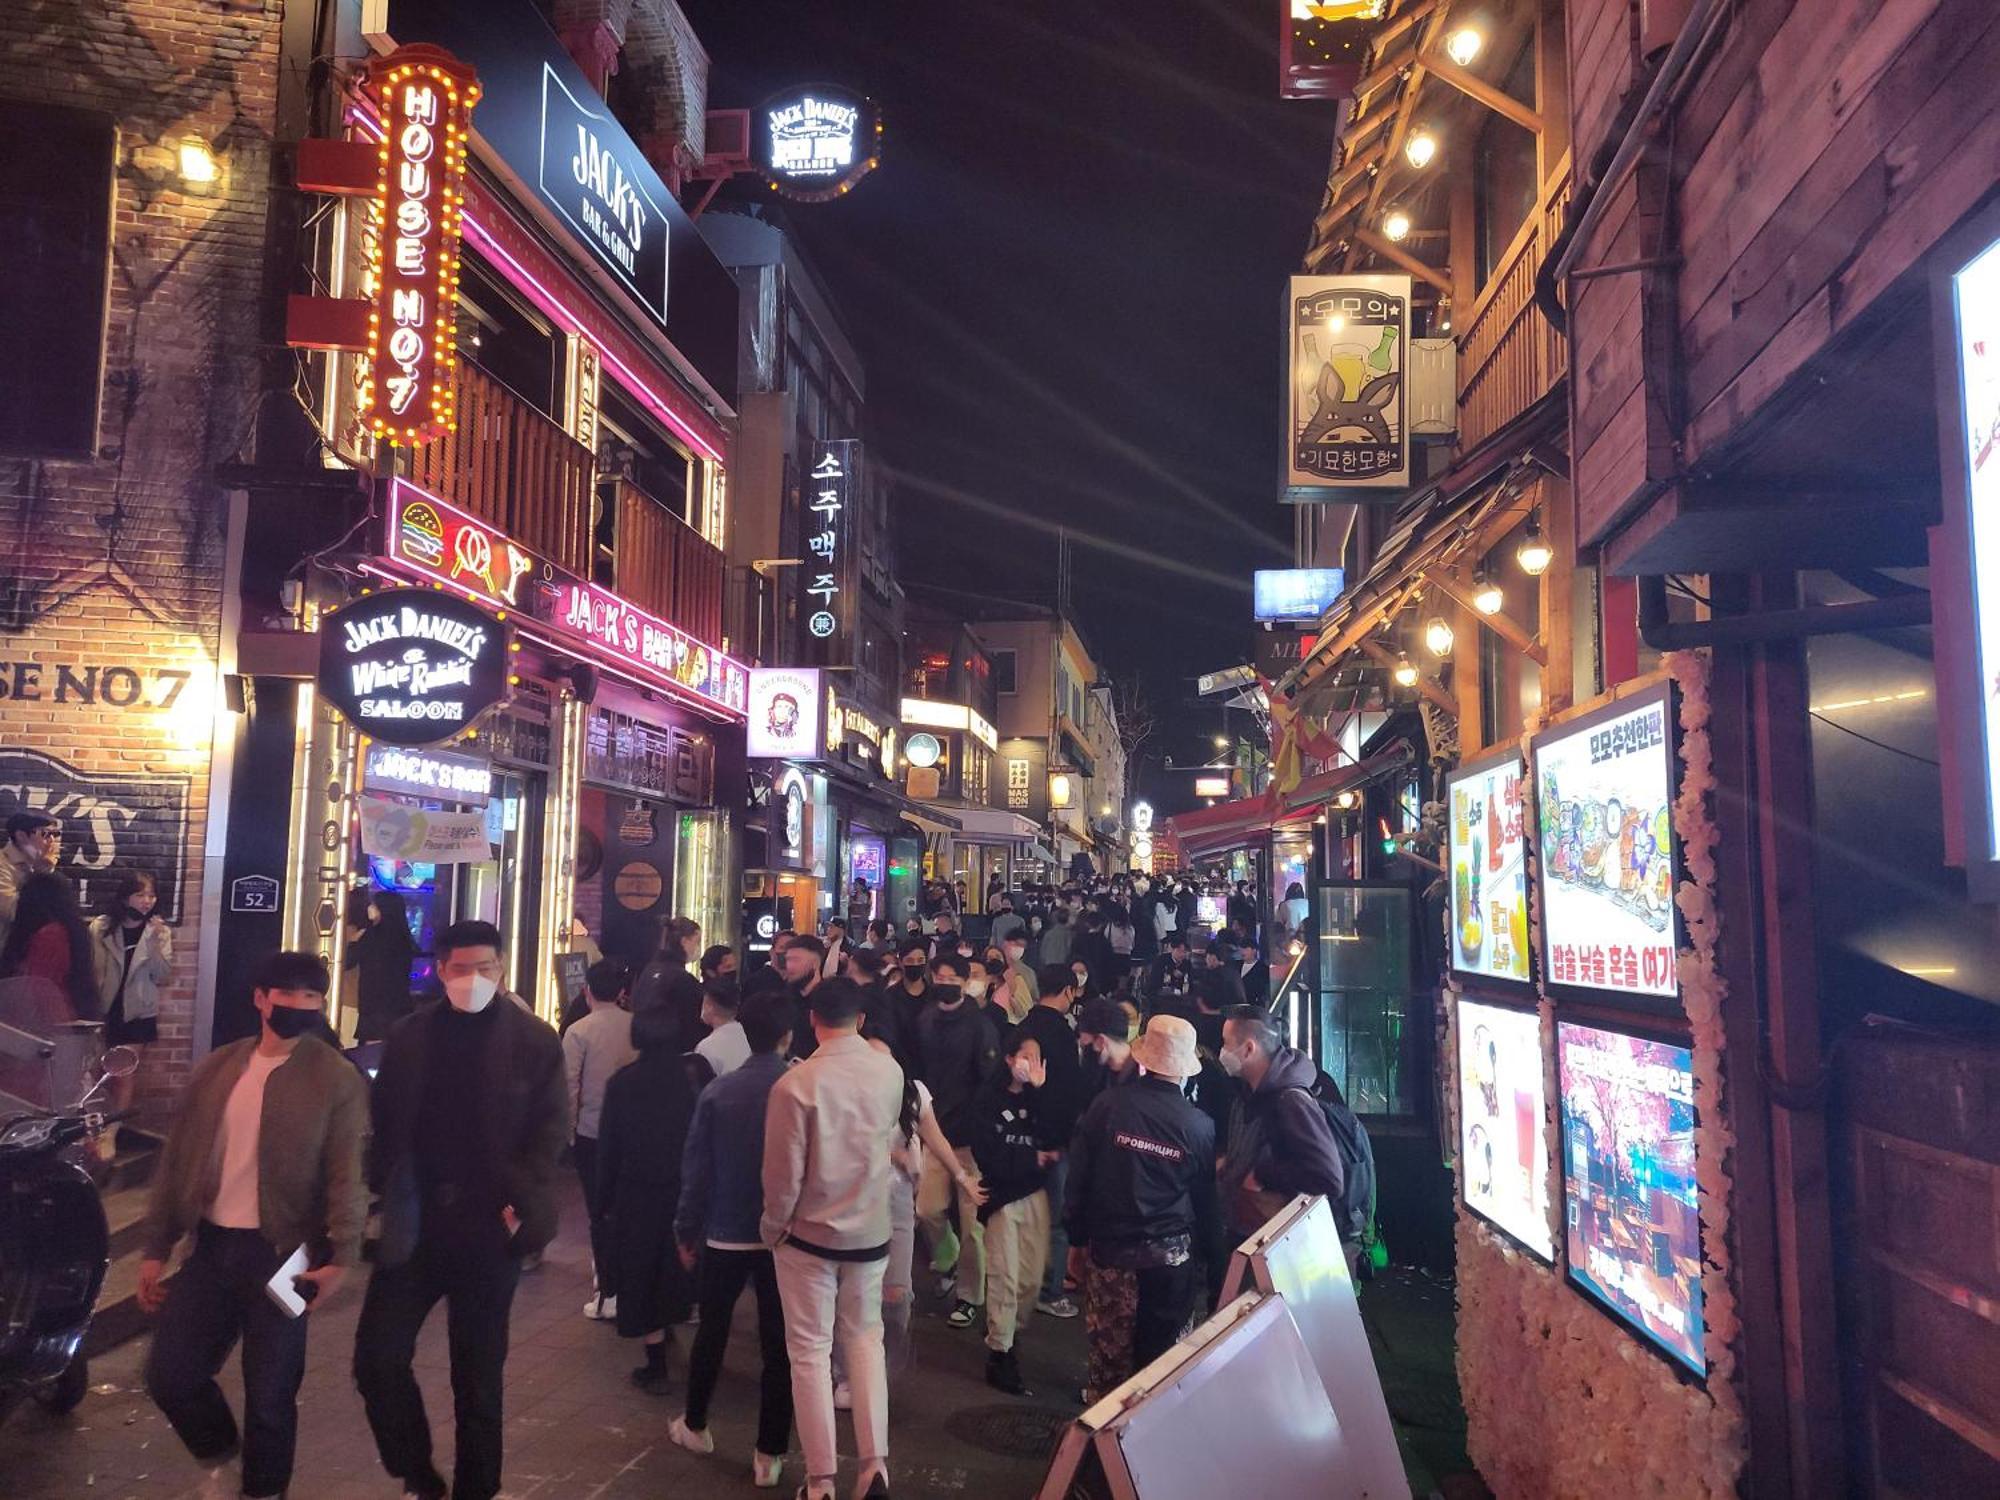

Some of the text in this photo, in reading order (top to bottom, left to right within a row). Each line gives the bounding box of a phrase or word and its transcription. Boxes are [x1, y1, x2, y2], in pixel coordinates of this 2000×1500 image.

[769, 104, 804, 133] JACK
[572, 123, 647, 251] JACK'S
[385, 86, 437, 416] HOUSE NO.7
[582, 197, 636, 277] BAR & GRILL
[1313, 297, 1389, 322] 모모의
[1307, 449, 1391, 474] 기묘한모험
[807, 452, 844, 607] 소주맥주
[343, 606, 487, 660] JACK DANIEL'S
[566, 586, 673, 671] JACK'S BAR
[53, 664, 193, 710] NO.7
[360, 699, 464, 720] SALOON
[245, 893, 264, 906] 52
[1116, 1134, 1181, 1159] ПРОВИНЦИЯ
